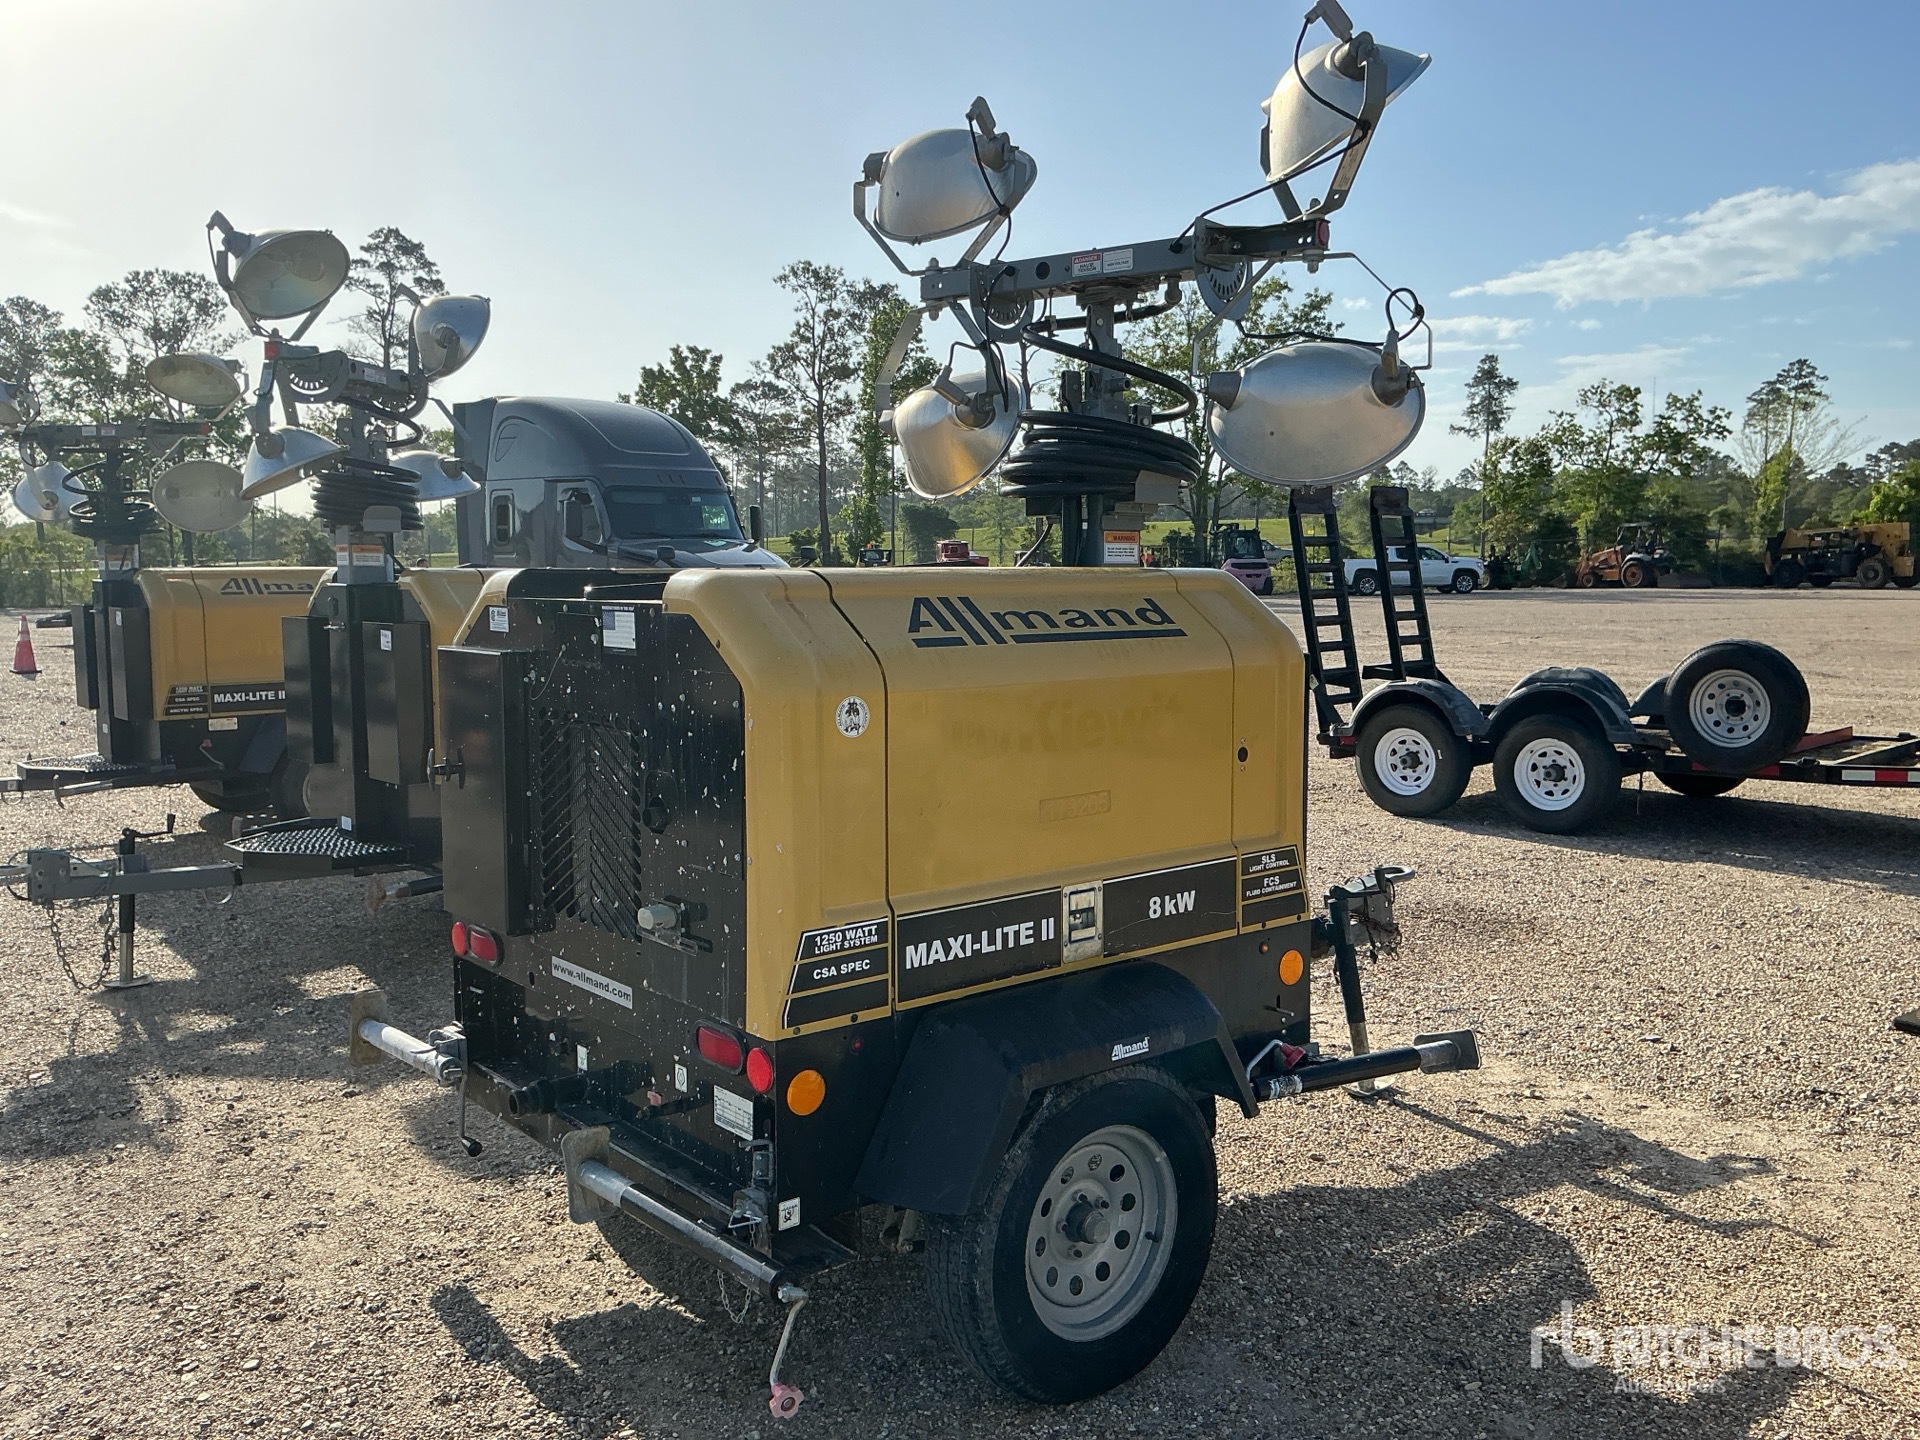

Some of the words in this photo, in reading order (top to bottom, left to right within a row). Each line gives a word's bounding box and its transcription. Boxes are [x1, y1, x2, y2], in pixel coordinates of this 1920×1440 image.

[908, 596, 1188, 648] Allmand
[214, 691, 276, 703] MAXI-LITE
[1249, 864, 1265, 872] LIGHT
[1265, 859, 1290, 869] CONTROL
[1261, 854, 1276, 864] SLS
[1246, 889, 1261, 897] FLUID
[1262, 881, 1297, 894] CONTAINMENT
[1264, 876, 1280, 887] FCS
[1149, 896, 1161, 919] 8
[1164, 890, 1196, 916] kW
[815, 932, 842, 946] 1250
[845, 925, 877, 940] WATT
[815, 942, 841, 954] LIGHT
[843, 934, 878, 948] SYSTEM
[905, 921, 1034, 969] MAXI-LITE
[1041, 917, 1055, 941] II
[813, 966, 838, 980] CSA
[840, 959, 870, 974] SPEC
[552, 962, 632, 1003] www.allmand.com
[1111, 1036, 1150, 1062] Allmand
